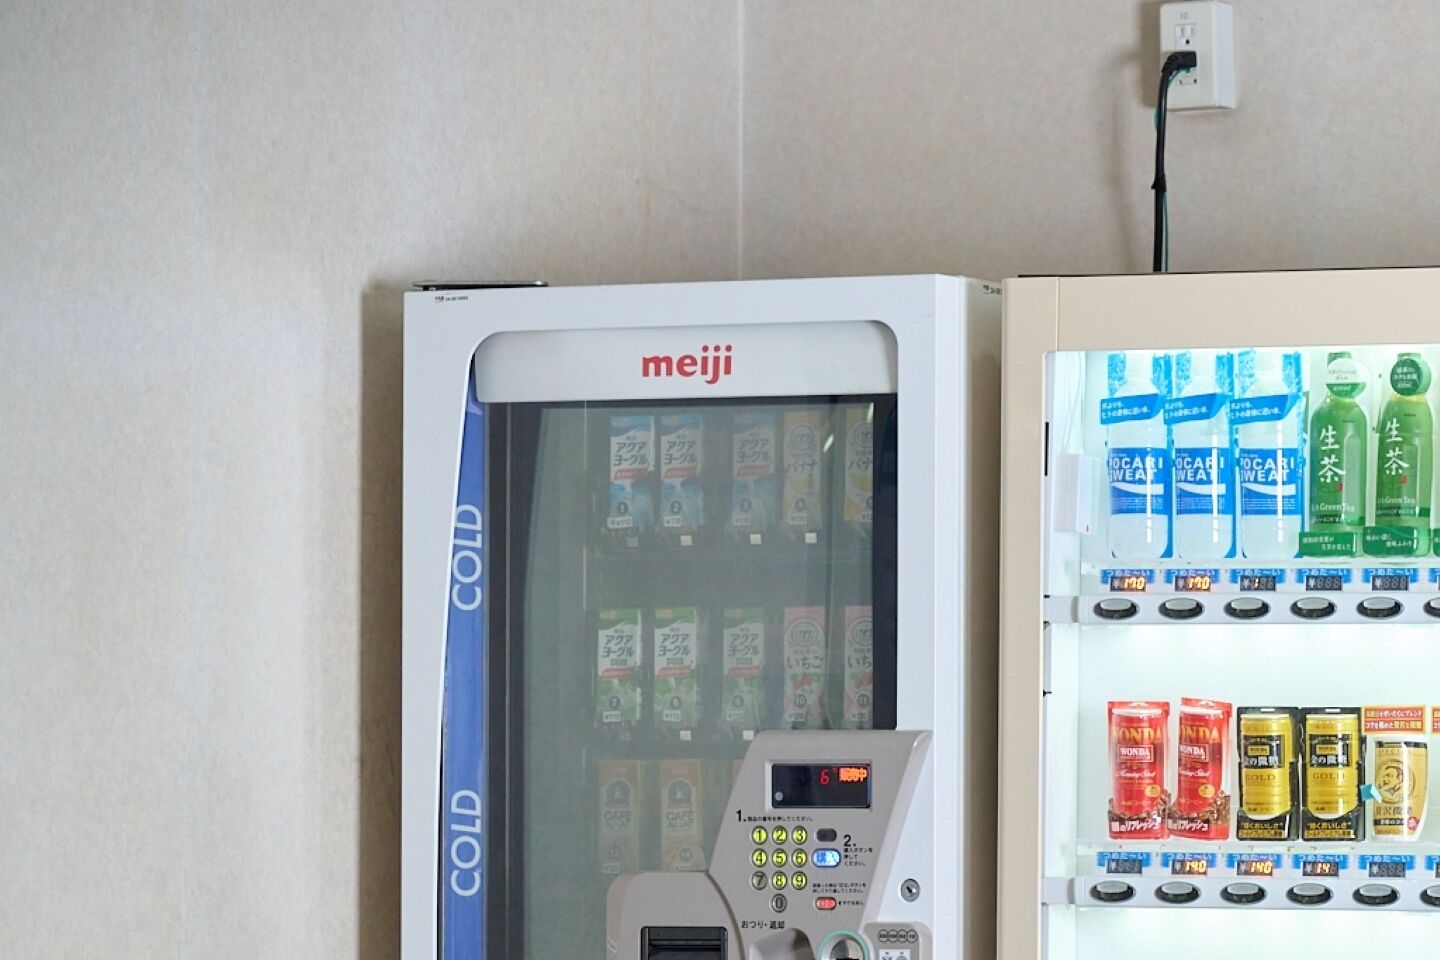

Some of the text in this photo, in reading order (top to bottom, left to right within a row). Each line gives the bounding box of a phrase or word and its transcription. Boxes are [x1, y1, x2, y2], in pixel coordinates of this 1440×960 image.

[641, 344, 733, 385] meiji
[1384, 417, 1410, 476] 生茶
[1318, 425, 1345, 483] 生茶
[455, 503, 482, 611] COLD
[819, 767, 829, 785] 6
[756, 829, 763, 842] 1
[776, 829, 784, 842] 2
[796, 829, 804, 842] 3
[843, 834, 857, 847] 2.
[452, 787, 482, 898] COLD
[755, 852, 763, 864] 4
[776, 852, 784, 864] 5
[796, 852, 804, 864] 6
[755, 874, 764, 886] 7
[775, 874, 784, 886] 8
[796, 874, 804, 886] 9
[775, 897, 784, 910] 0
[741, 920, 785, 930] おつり・返却
